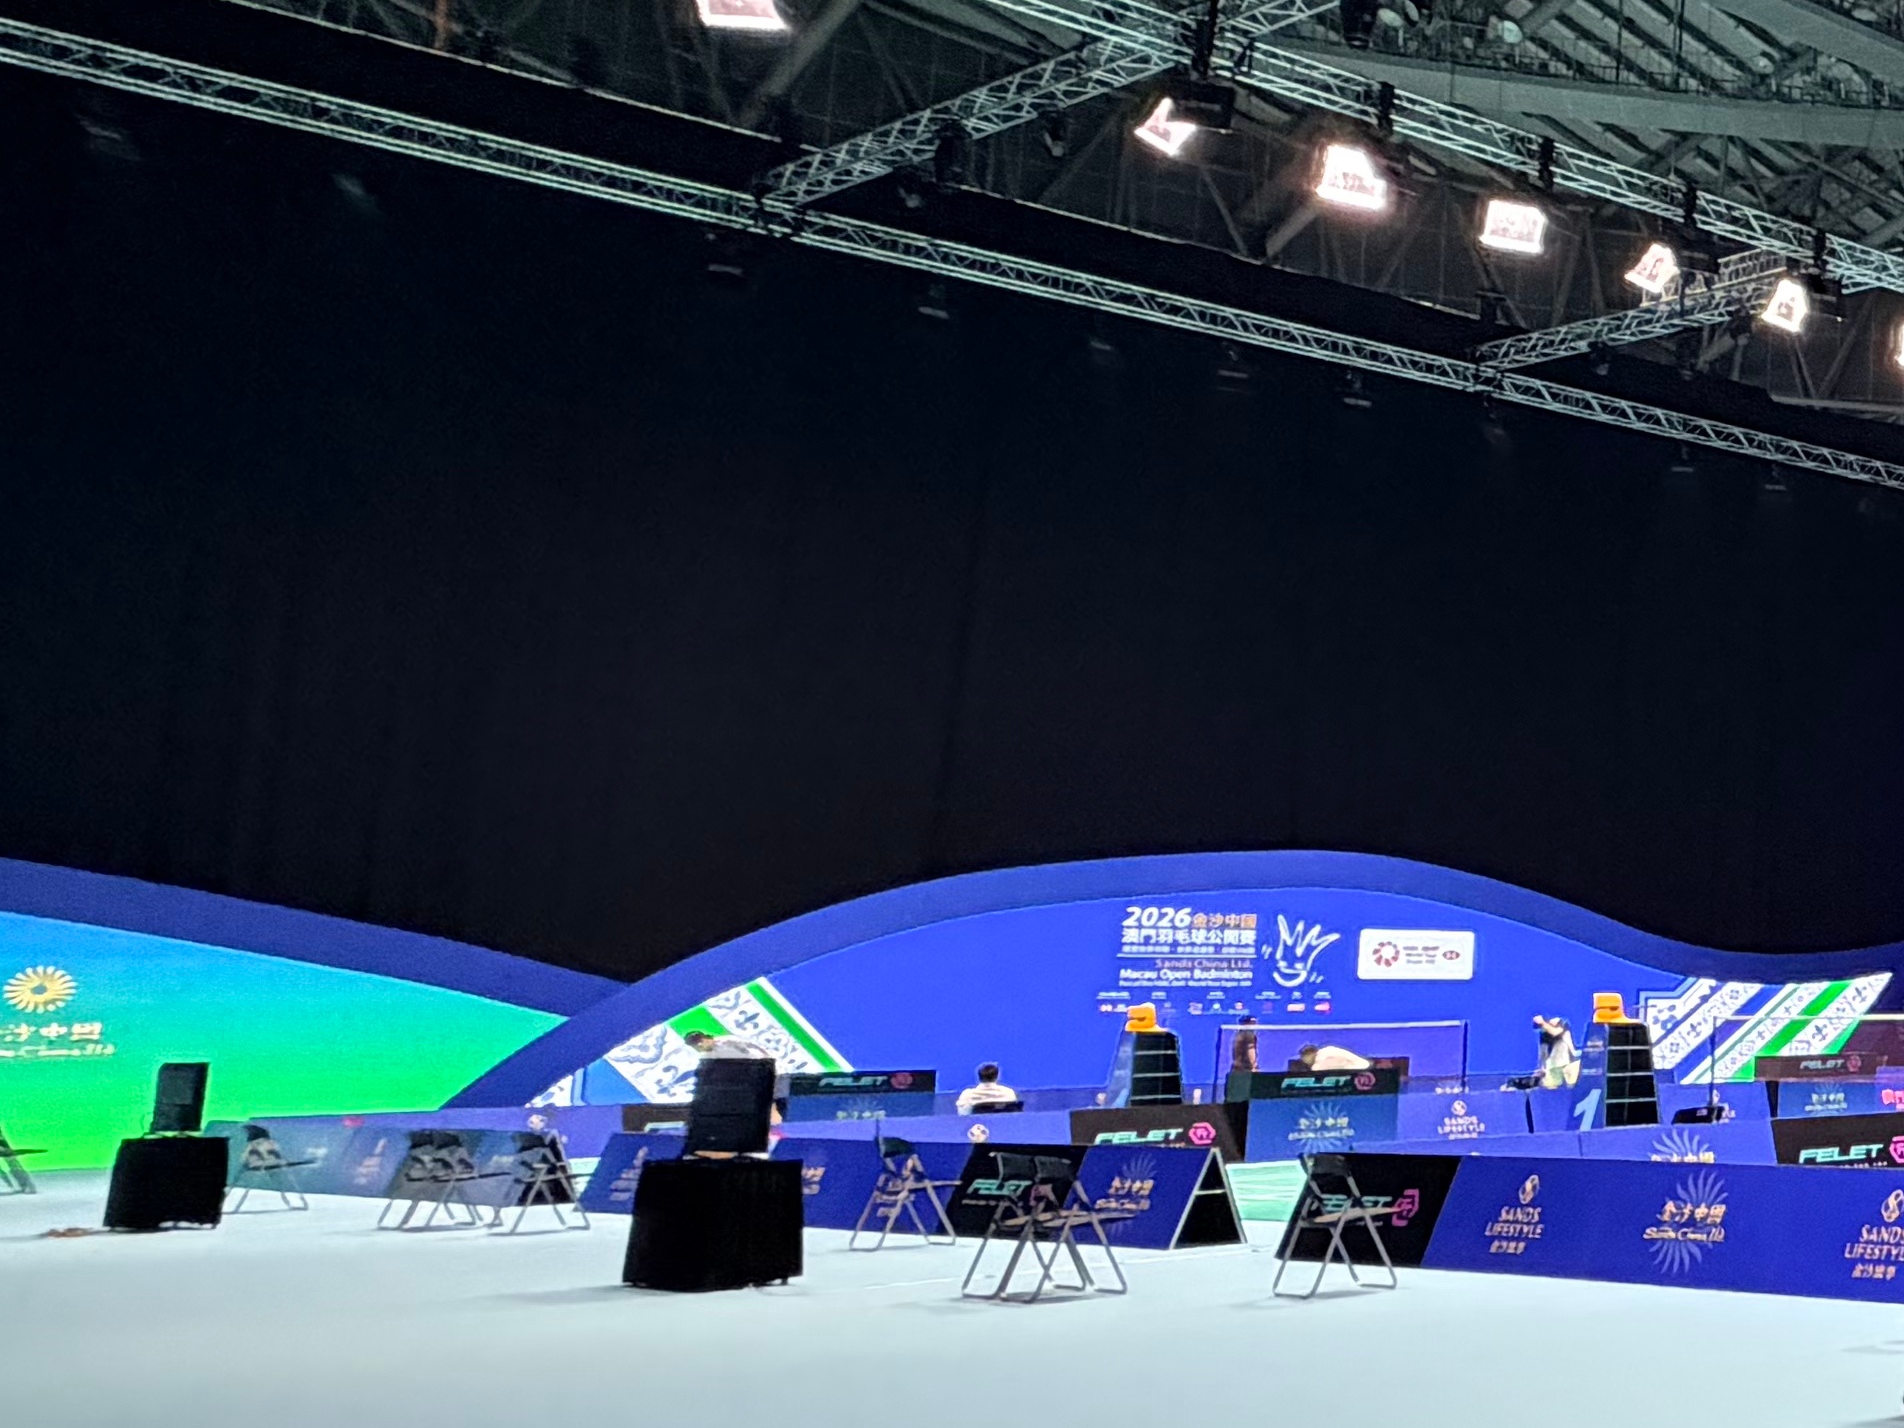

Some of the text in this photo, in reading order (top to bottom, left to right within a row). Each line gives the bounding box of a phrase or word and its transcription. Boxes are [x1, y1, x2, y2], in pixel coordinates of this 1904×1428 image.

[1122, 906, 1192, 928] 2026
[1094, 1128, 1184, 1145] FELET
[1799, 1144, 1884, 1164] FELET
[1498, 1206, 1542, 1224] SANDS
[1484, 1221, 1545, 1239] LIFESTYLE
